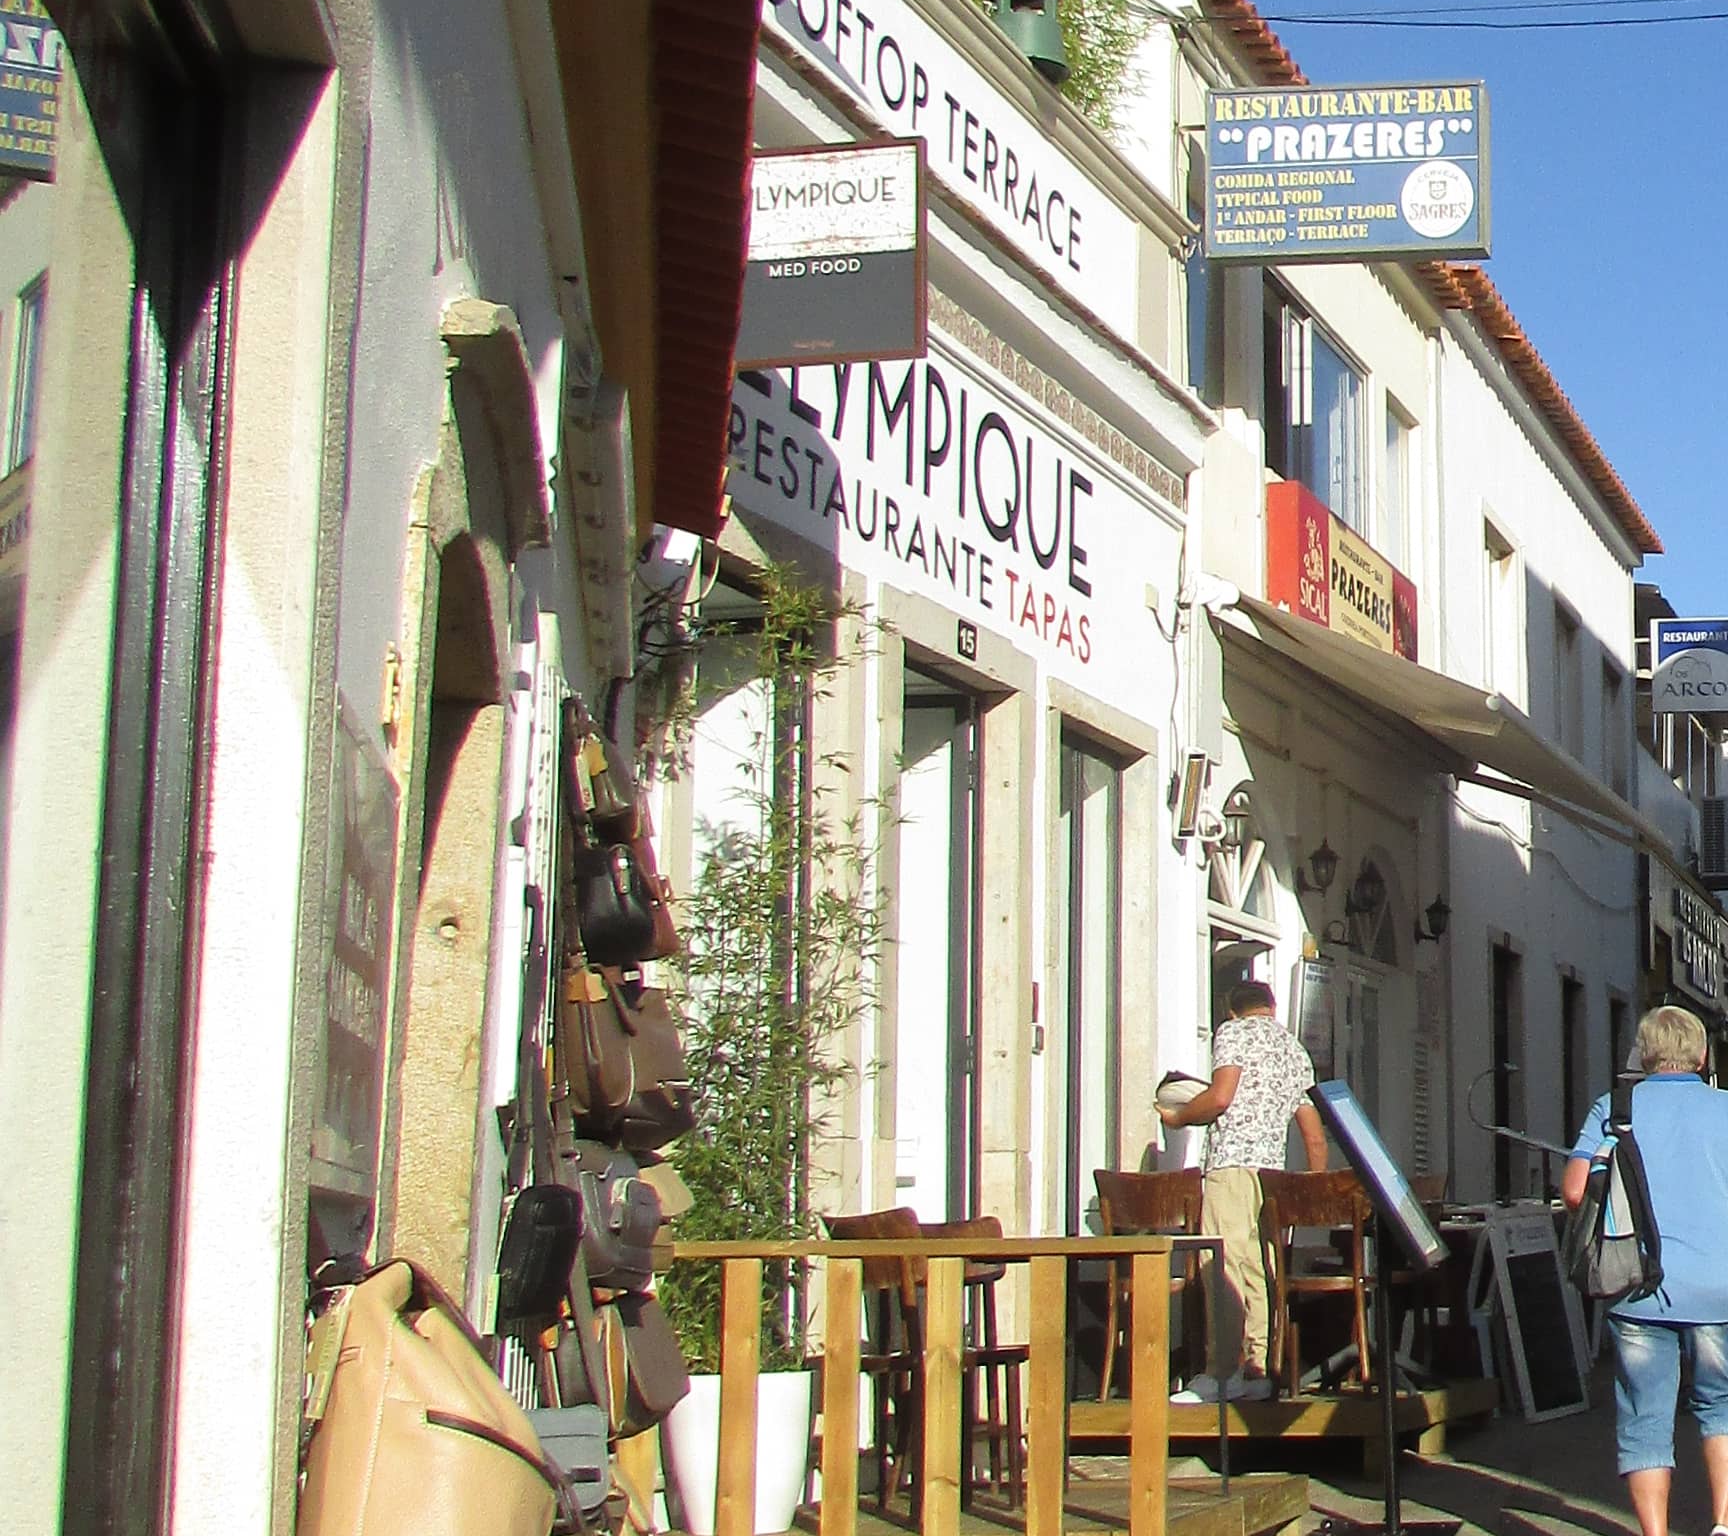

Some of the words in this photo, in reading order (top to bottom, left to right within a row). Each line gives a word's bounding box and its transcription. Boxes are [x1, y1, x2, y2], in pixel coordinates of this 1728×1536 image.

[1214, 87, 1473, 123] RESTAURANTE-BAR
[755, 176, 897, 212] LYMPIQUE
[944, 91, 1082, 273] TERRACE
[1214, 173, 1275, 190] COMIDA
[1277, 169, 1356, 188] REGIONAL
[1214, 191, 1280, 209] TYPICAL
[1283, 188, 1323, 205] FOOD
[1408, 201, 1468, 222] SAGRES
[1234, 208, 1287, 226] ANDAR
[1299, 205, 1345, 223] FIRST
[1347, 204, 1398, 221] FLOOR
[1214, 227, 1287, 247] TERRAÇO
[1297, 223, 1369, 241] TERRACE
[768, 263, 806, 279] MED
[811, 257, 862, 275] FOOD
[738, 359, 1094, 599] LYMPIQUE
[728, 402, 994, 610] RESTAURANTE
[1004, 567, 1092, 665] TAPAS
[1299, 576, 1328, 623] SICAL
[1331, 558, 1391, 633] PRAZERES
[959, 626, 976, 655] 15
